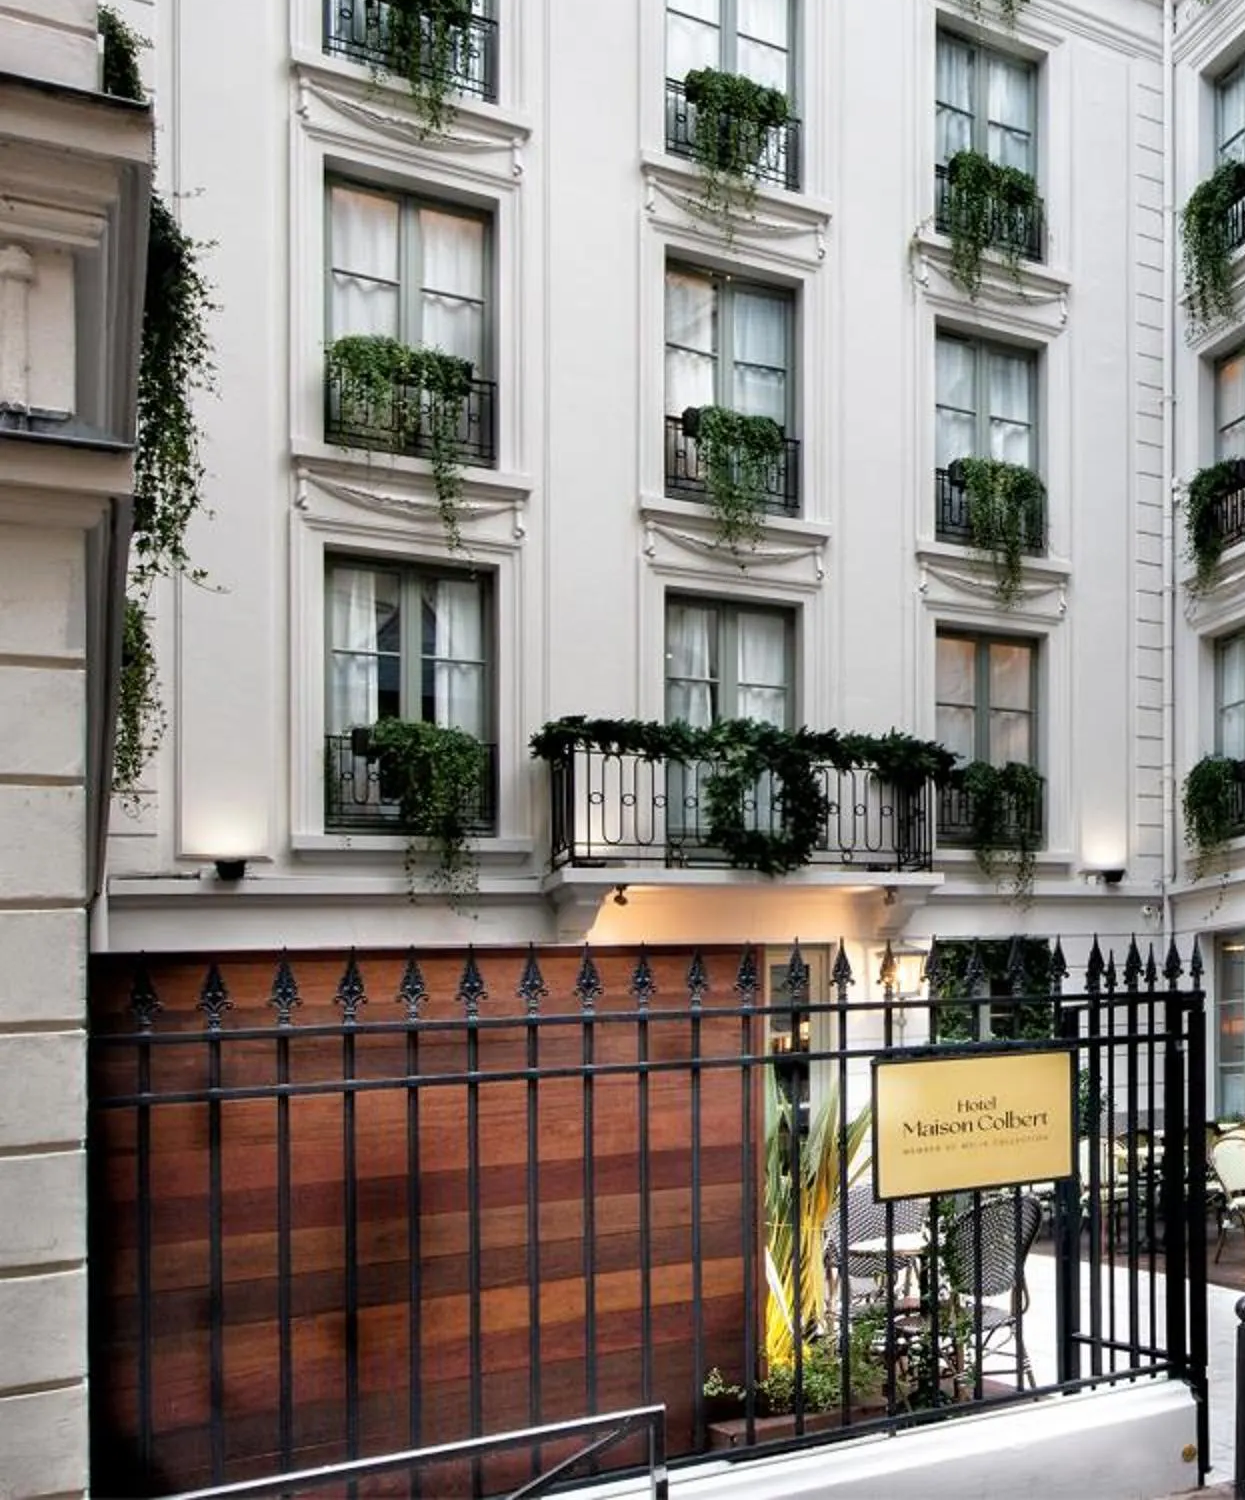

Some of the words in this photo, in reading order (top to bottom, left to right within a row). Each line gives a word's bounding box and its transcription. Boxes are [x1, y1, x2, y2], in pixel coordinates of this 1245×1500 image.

[957, 1096, 997, 1113] Hotel
[902, 1118, 973, 1138] Maison
[977, 1110, 1048, 1132] Colbert
